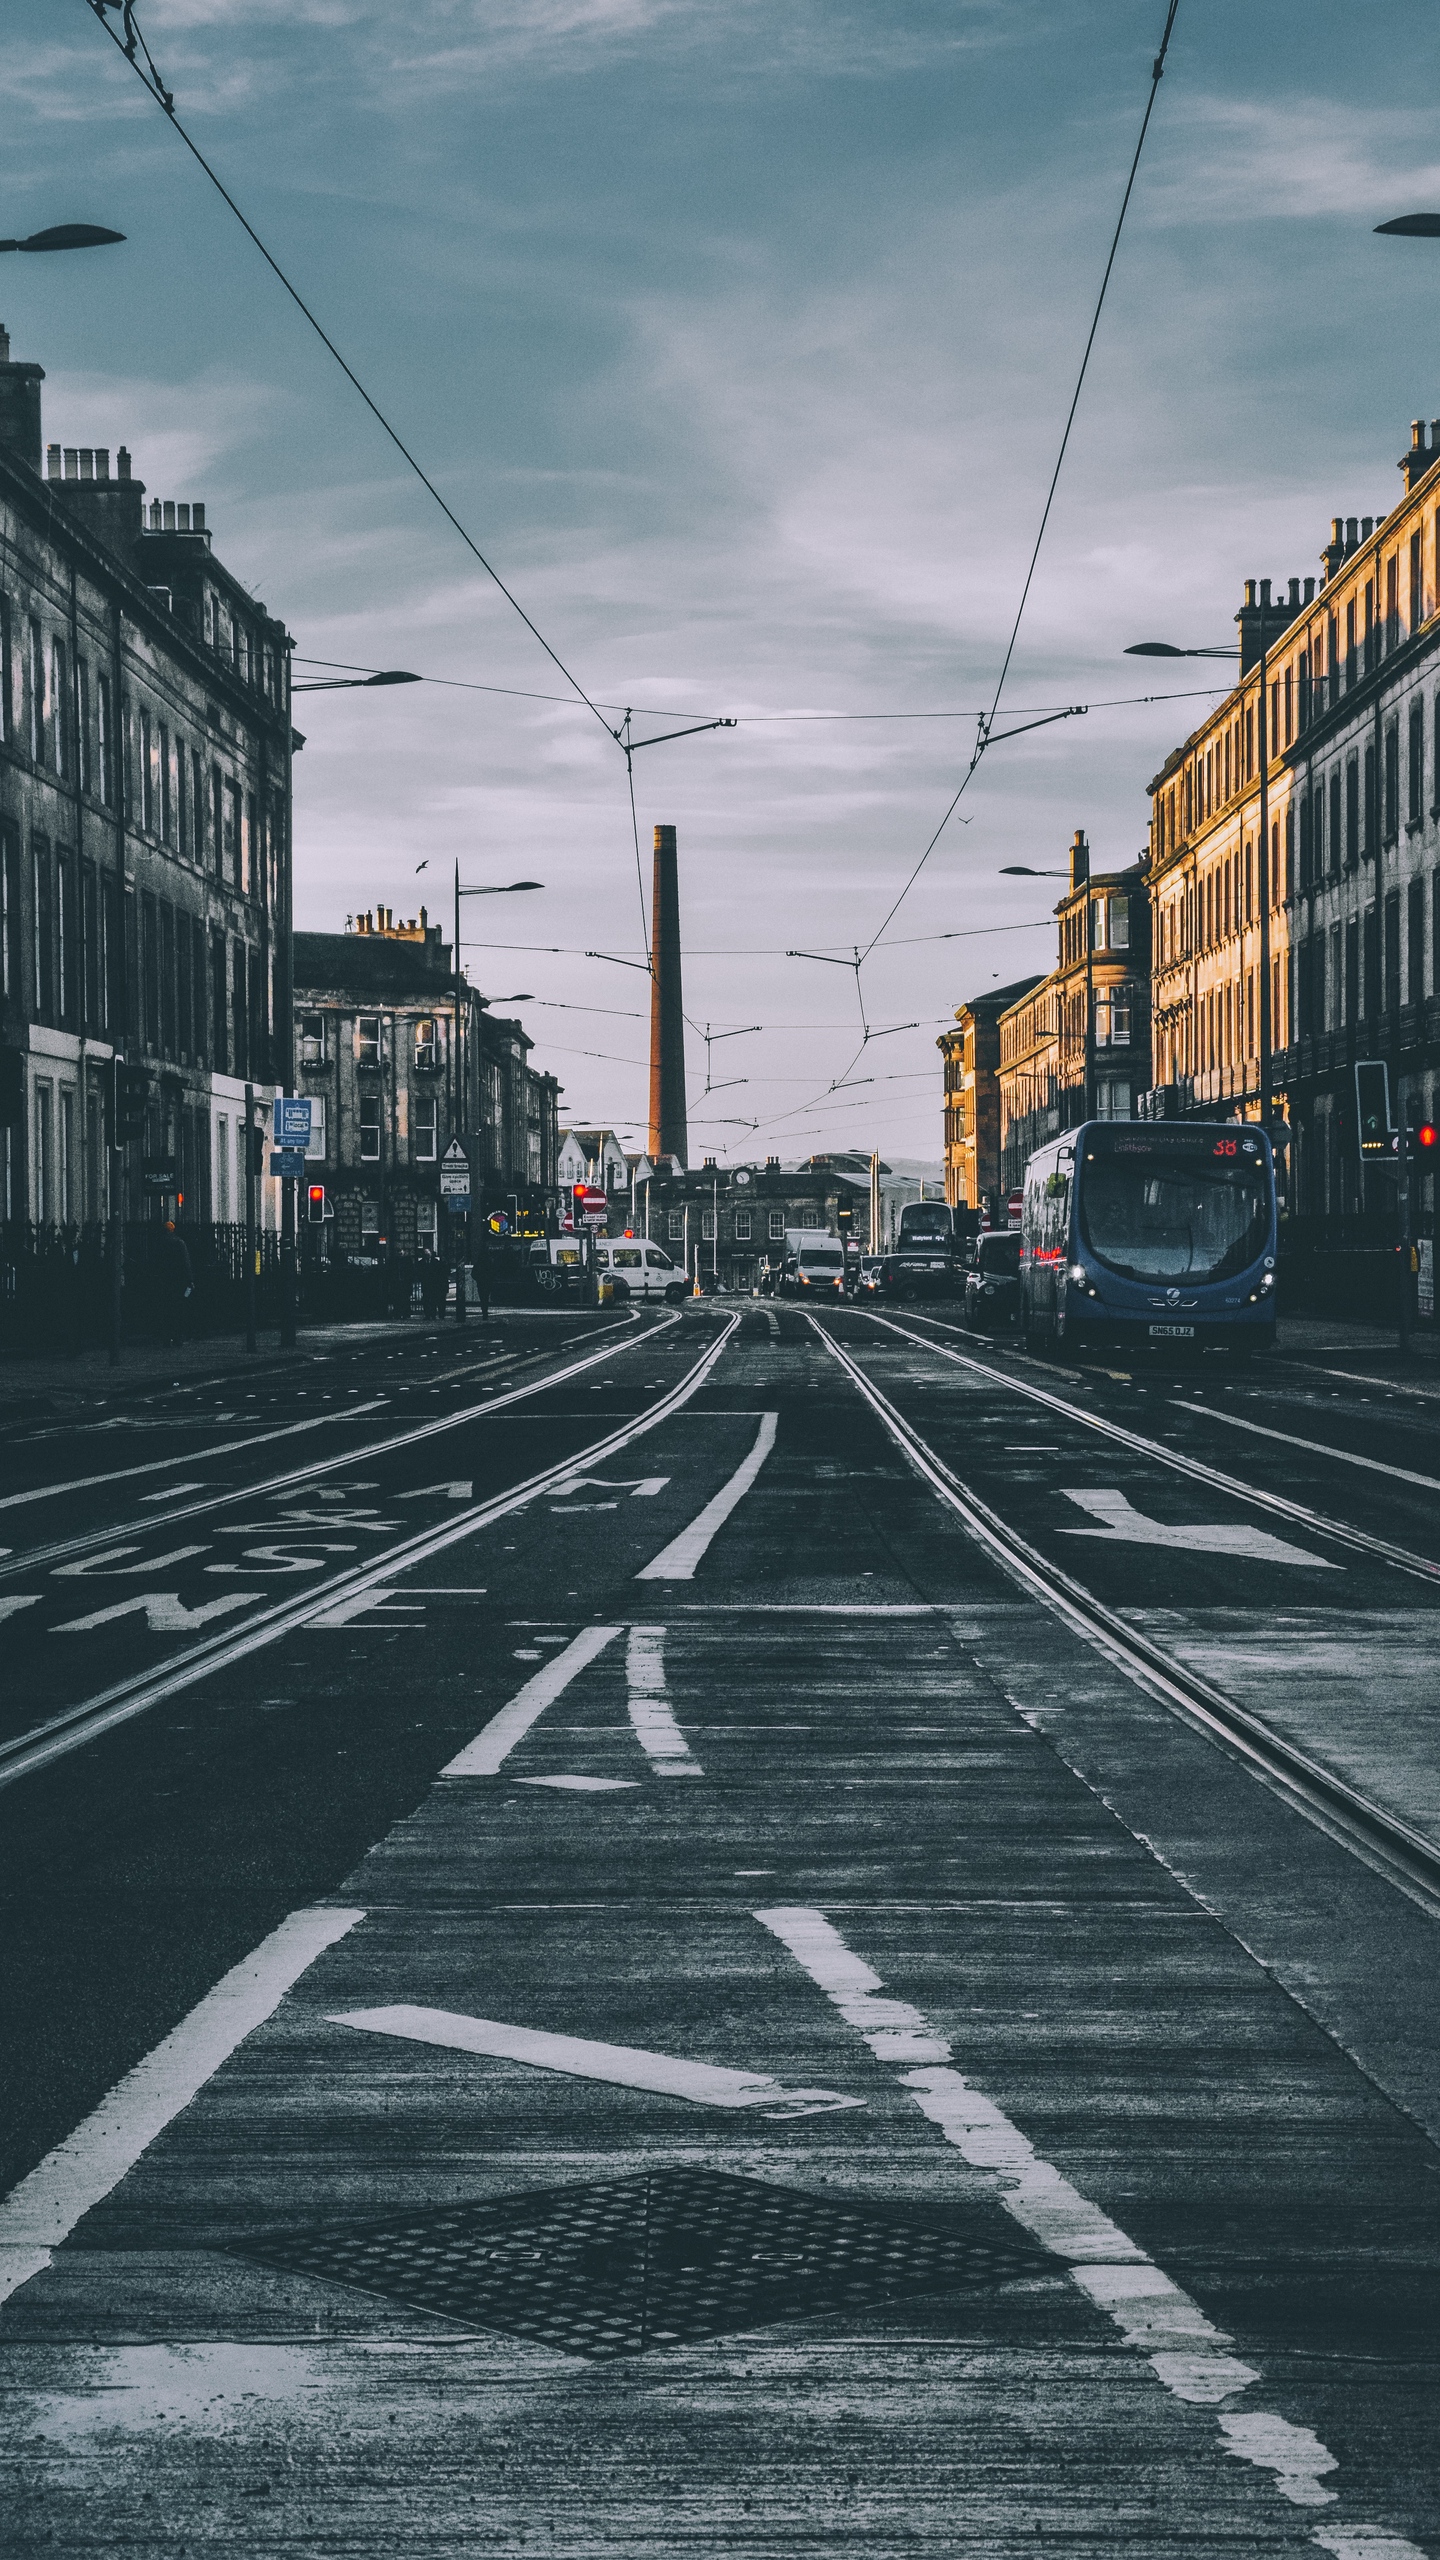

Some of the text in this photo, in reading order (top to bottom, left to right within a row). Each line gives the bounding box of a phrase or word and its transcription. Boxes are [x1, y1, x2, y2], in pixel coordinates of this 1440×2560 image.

[1213, 1139, 1237, 1157] 38
[158, 1172, 175, 1180] SALE
[1152, 1326, 1174, 1335] SN65
[0, 1543, 358, 1576] US
[0, 1589, 487, 1629] NE
